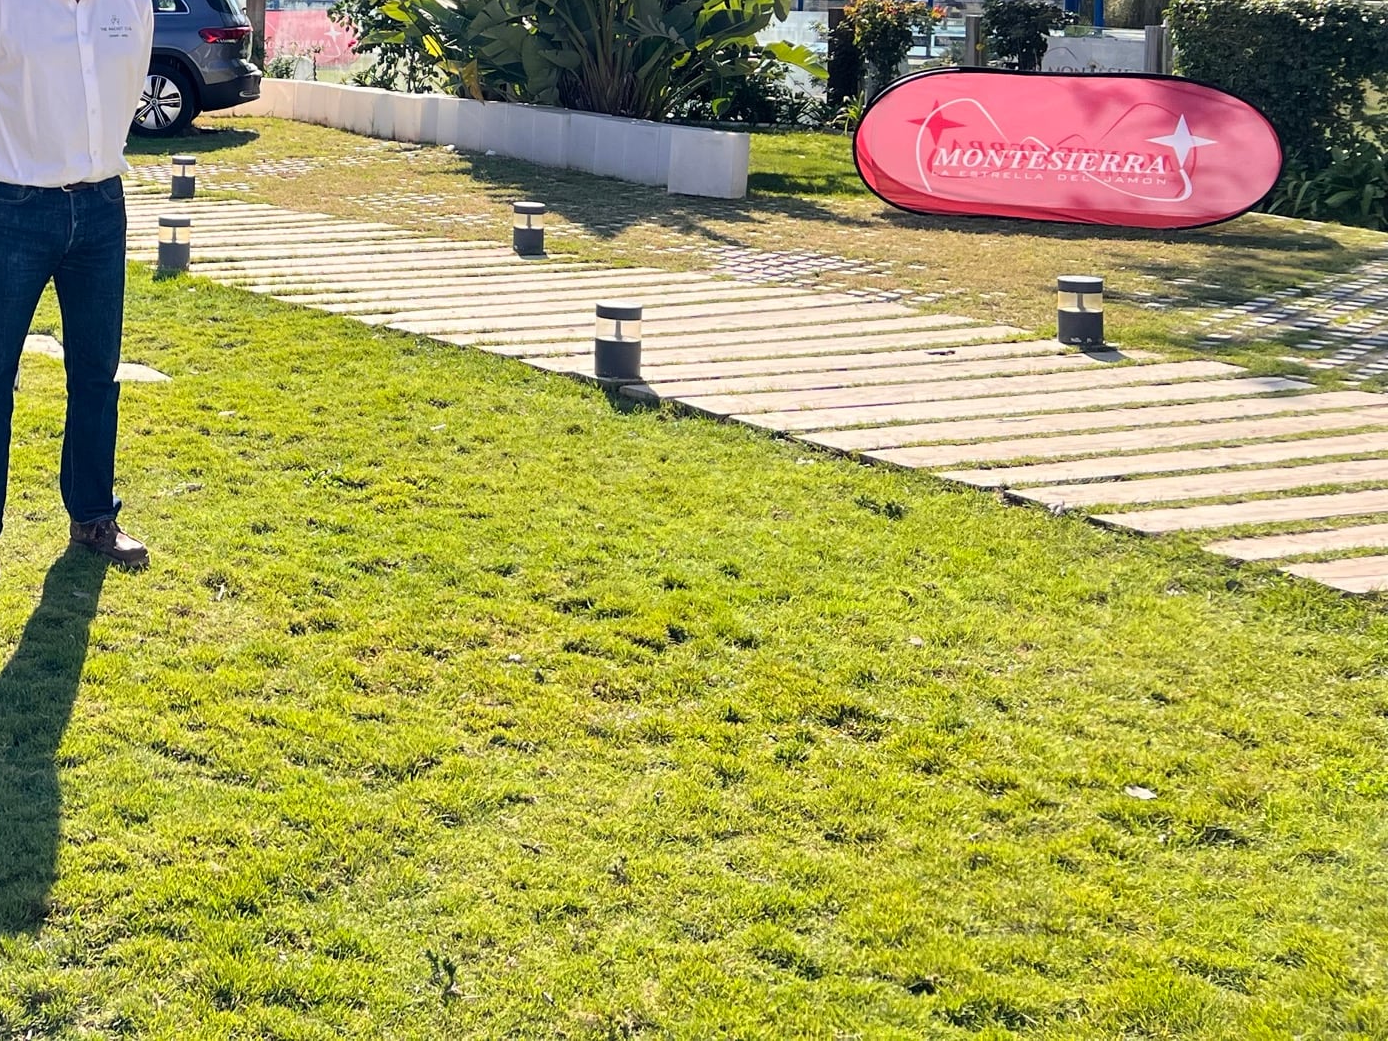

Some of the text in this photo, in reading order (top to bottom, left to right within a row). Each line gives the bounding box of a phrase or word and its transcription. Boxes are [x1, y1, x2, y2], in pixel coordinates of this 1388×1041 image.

[933, 148, 1167, 175] MONTESIERRA
[959, 170, 1044, 180] ESTRELLA
[1057, 174, 1089, 183] DEL
